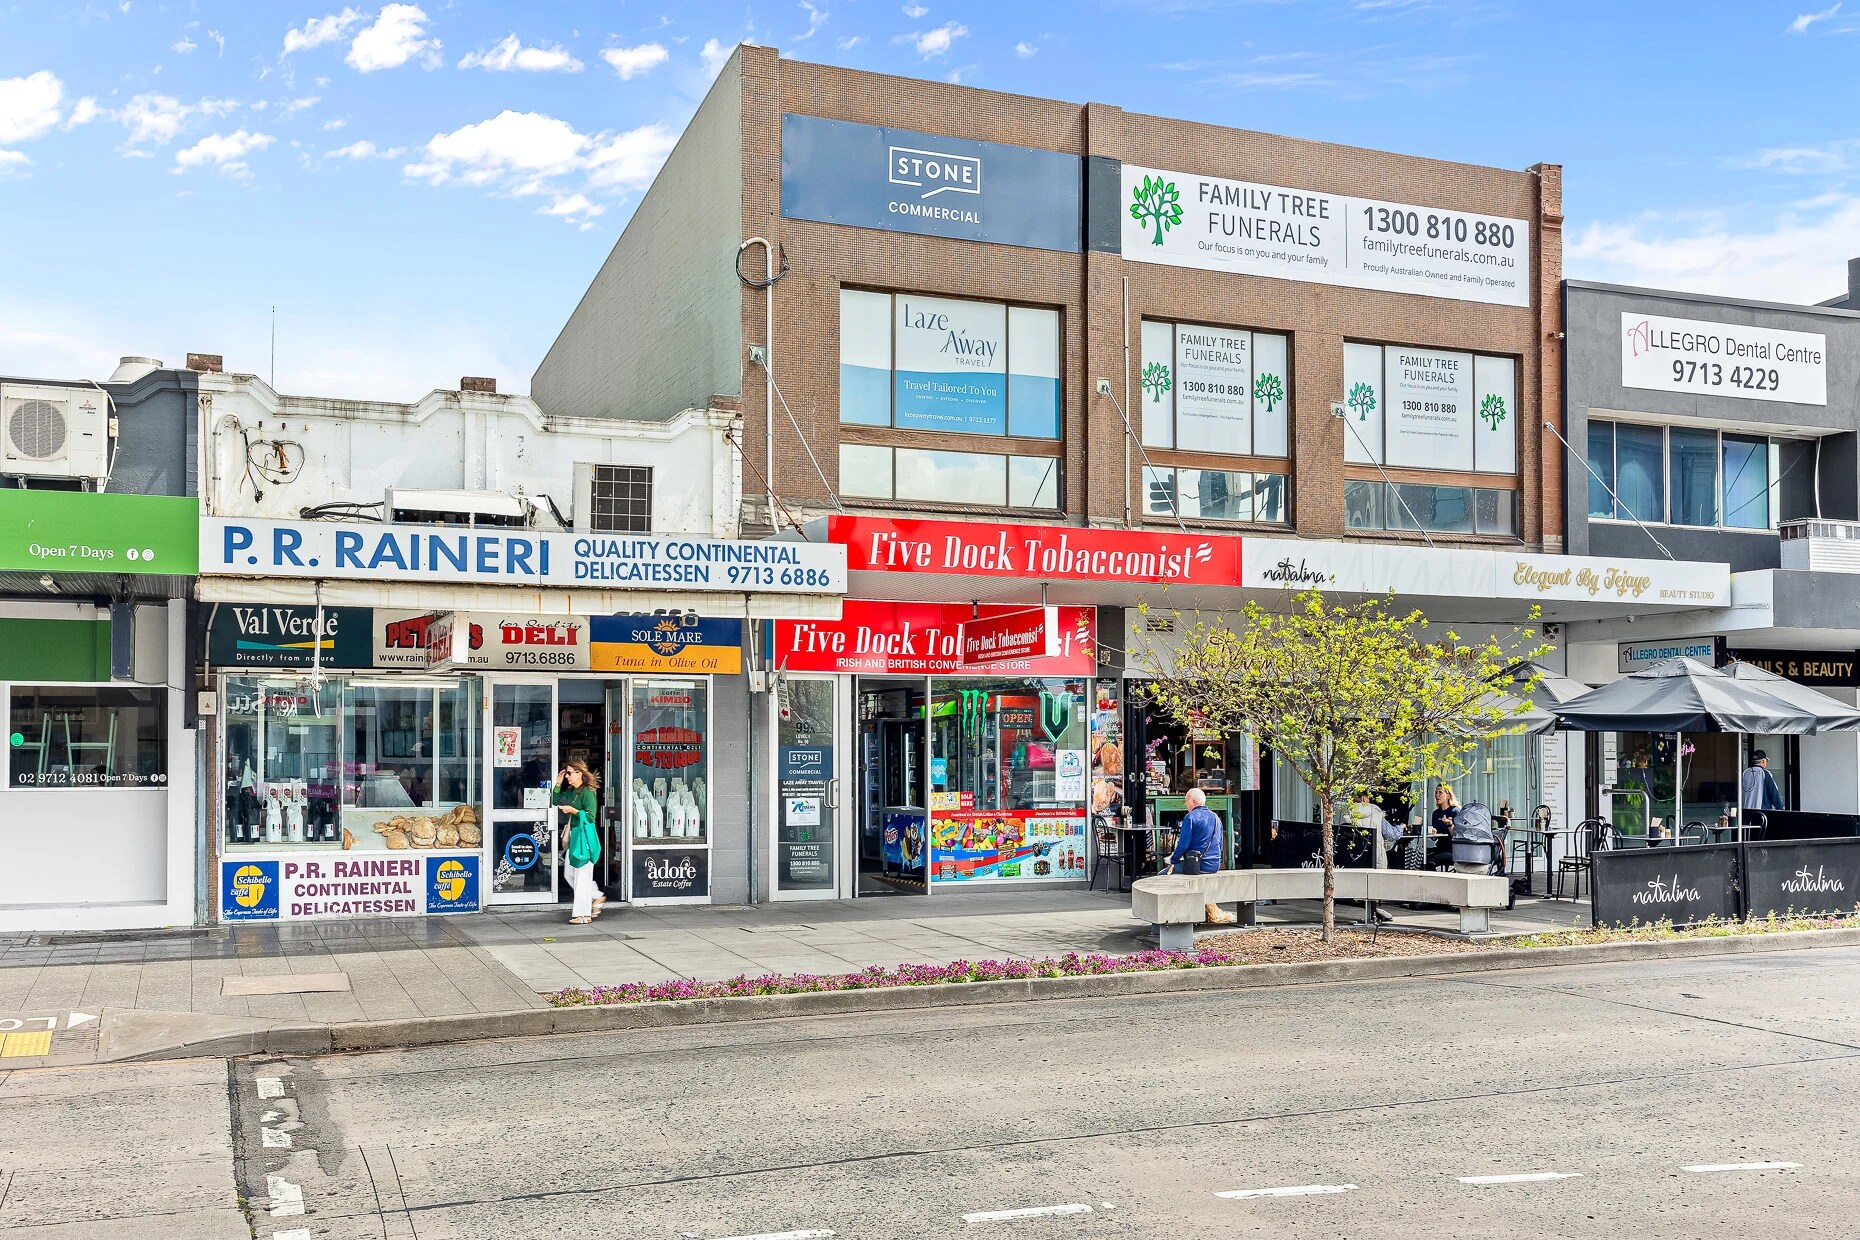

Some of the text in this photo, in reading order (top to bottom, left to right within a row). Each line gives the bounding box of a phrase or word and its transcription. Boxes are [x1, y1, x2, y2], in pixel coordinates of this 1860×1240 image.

[898, 157, 973, 184] STONE
[1199, 182, 1330, 220] FAMILY TREE
[888, 201, 980, 224] COMMERCIAL
[1209, 212, 1321, 247] FUNERALS
[1363, 206, 1515, 248] 1300 810 880
[1198, 240, 1329, 268] Our focus is on you and your family
[1363, 236, 1515, 268] familytreefunerals.com.au
[1363, 262, 1516, 288] Proudly Australian Owned and Family Operated
[905, 303, 949, 331] Laze
[940, 330, 997, 367] Away
[1180, 333, 1246, 350] FAMILY TREE
[1627, 320, 1821, 364] ALLEGRO Dental Centre
[955, 357, 986, 368] TRAVEL
[1185, 348, 1242, 365] FUNERALS
[1400, 355, 1459, 370] FAMILY TREE
[1404, 369, 1455, 384] FUNERALS
[1672, 359, 1779, 391] 9713 4229
[904, 380, 997, 397] Travel Tailored To You
[1183, 381, 1244, 396] 1300 810 880
[1182, 394, 1244, 405] familytreefunerals.com.au
[1402, 400, 1457, 414] 1300 810 880
[29, 543, 114, 561] Open 7 Days
[223, 525, 549, 576] P. R. RAINERI
[574, 538, 801, 565] QUALITY CONTINENTAL
[867, 531, 1193, 579] Five Dock Tobacconist
[574, 560, 830, 587] DELICATESSEN 9713 6886
[1263, 557, 1326, 583] natalina
[1513, 560, 1572, 592] Elegant
[1576, 567, 1600, 596] By
[1660, 589, 1715, 600] BEAUTY STUDIO
[232, 607, 269, 635] Val
[502, 626, 578, 646] DELI
[631, 630, 703, 643] SOLE MARE
[791, 623, 846, 653] Five
[854, 621, 918, 655] Dock
[966, 637, 979, 653] Five
[981, 630, 997, 650] Dock
[998, 626, 1038, 648] Tobacconist
[236, 653, 335, 663] Directly from naure
[505, 651, 575, 665] 9713.6886
[615, 655, 718, 668] Tuna in Olive Oil
[1623, 644, 1711, 663] ALLEGRO DENTAL CENTRE
[836, 657, 1031, 670] IRISH AND BRITISH STORE
[1788, 661, 1853, 677] & BEAUTY
[651, 695, 691, 704] KIMBO
[1003, 713, 1032, 723] OPEN
[18, 773, 148, 784] 02 9712 4081 Open 7 Days
[284, 860, 420, 880] P.R. RAINERI
[440, 870, 473, 880] Schibello
[645, 857, 697, 879] adore
[237, 875, 272, 885] Schibello
[652, 880, 692, 890] Estate Coffee
[1781, 865, 1845, 893] natalina
[294, 881, 412, 897] CONTINENTAL
[1633, 874, 1701, 905] natalina
[291, 899, 416, 916] DELICATESSEN
